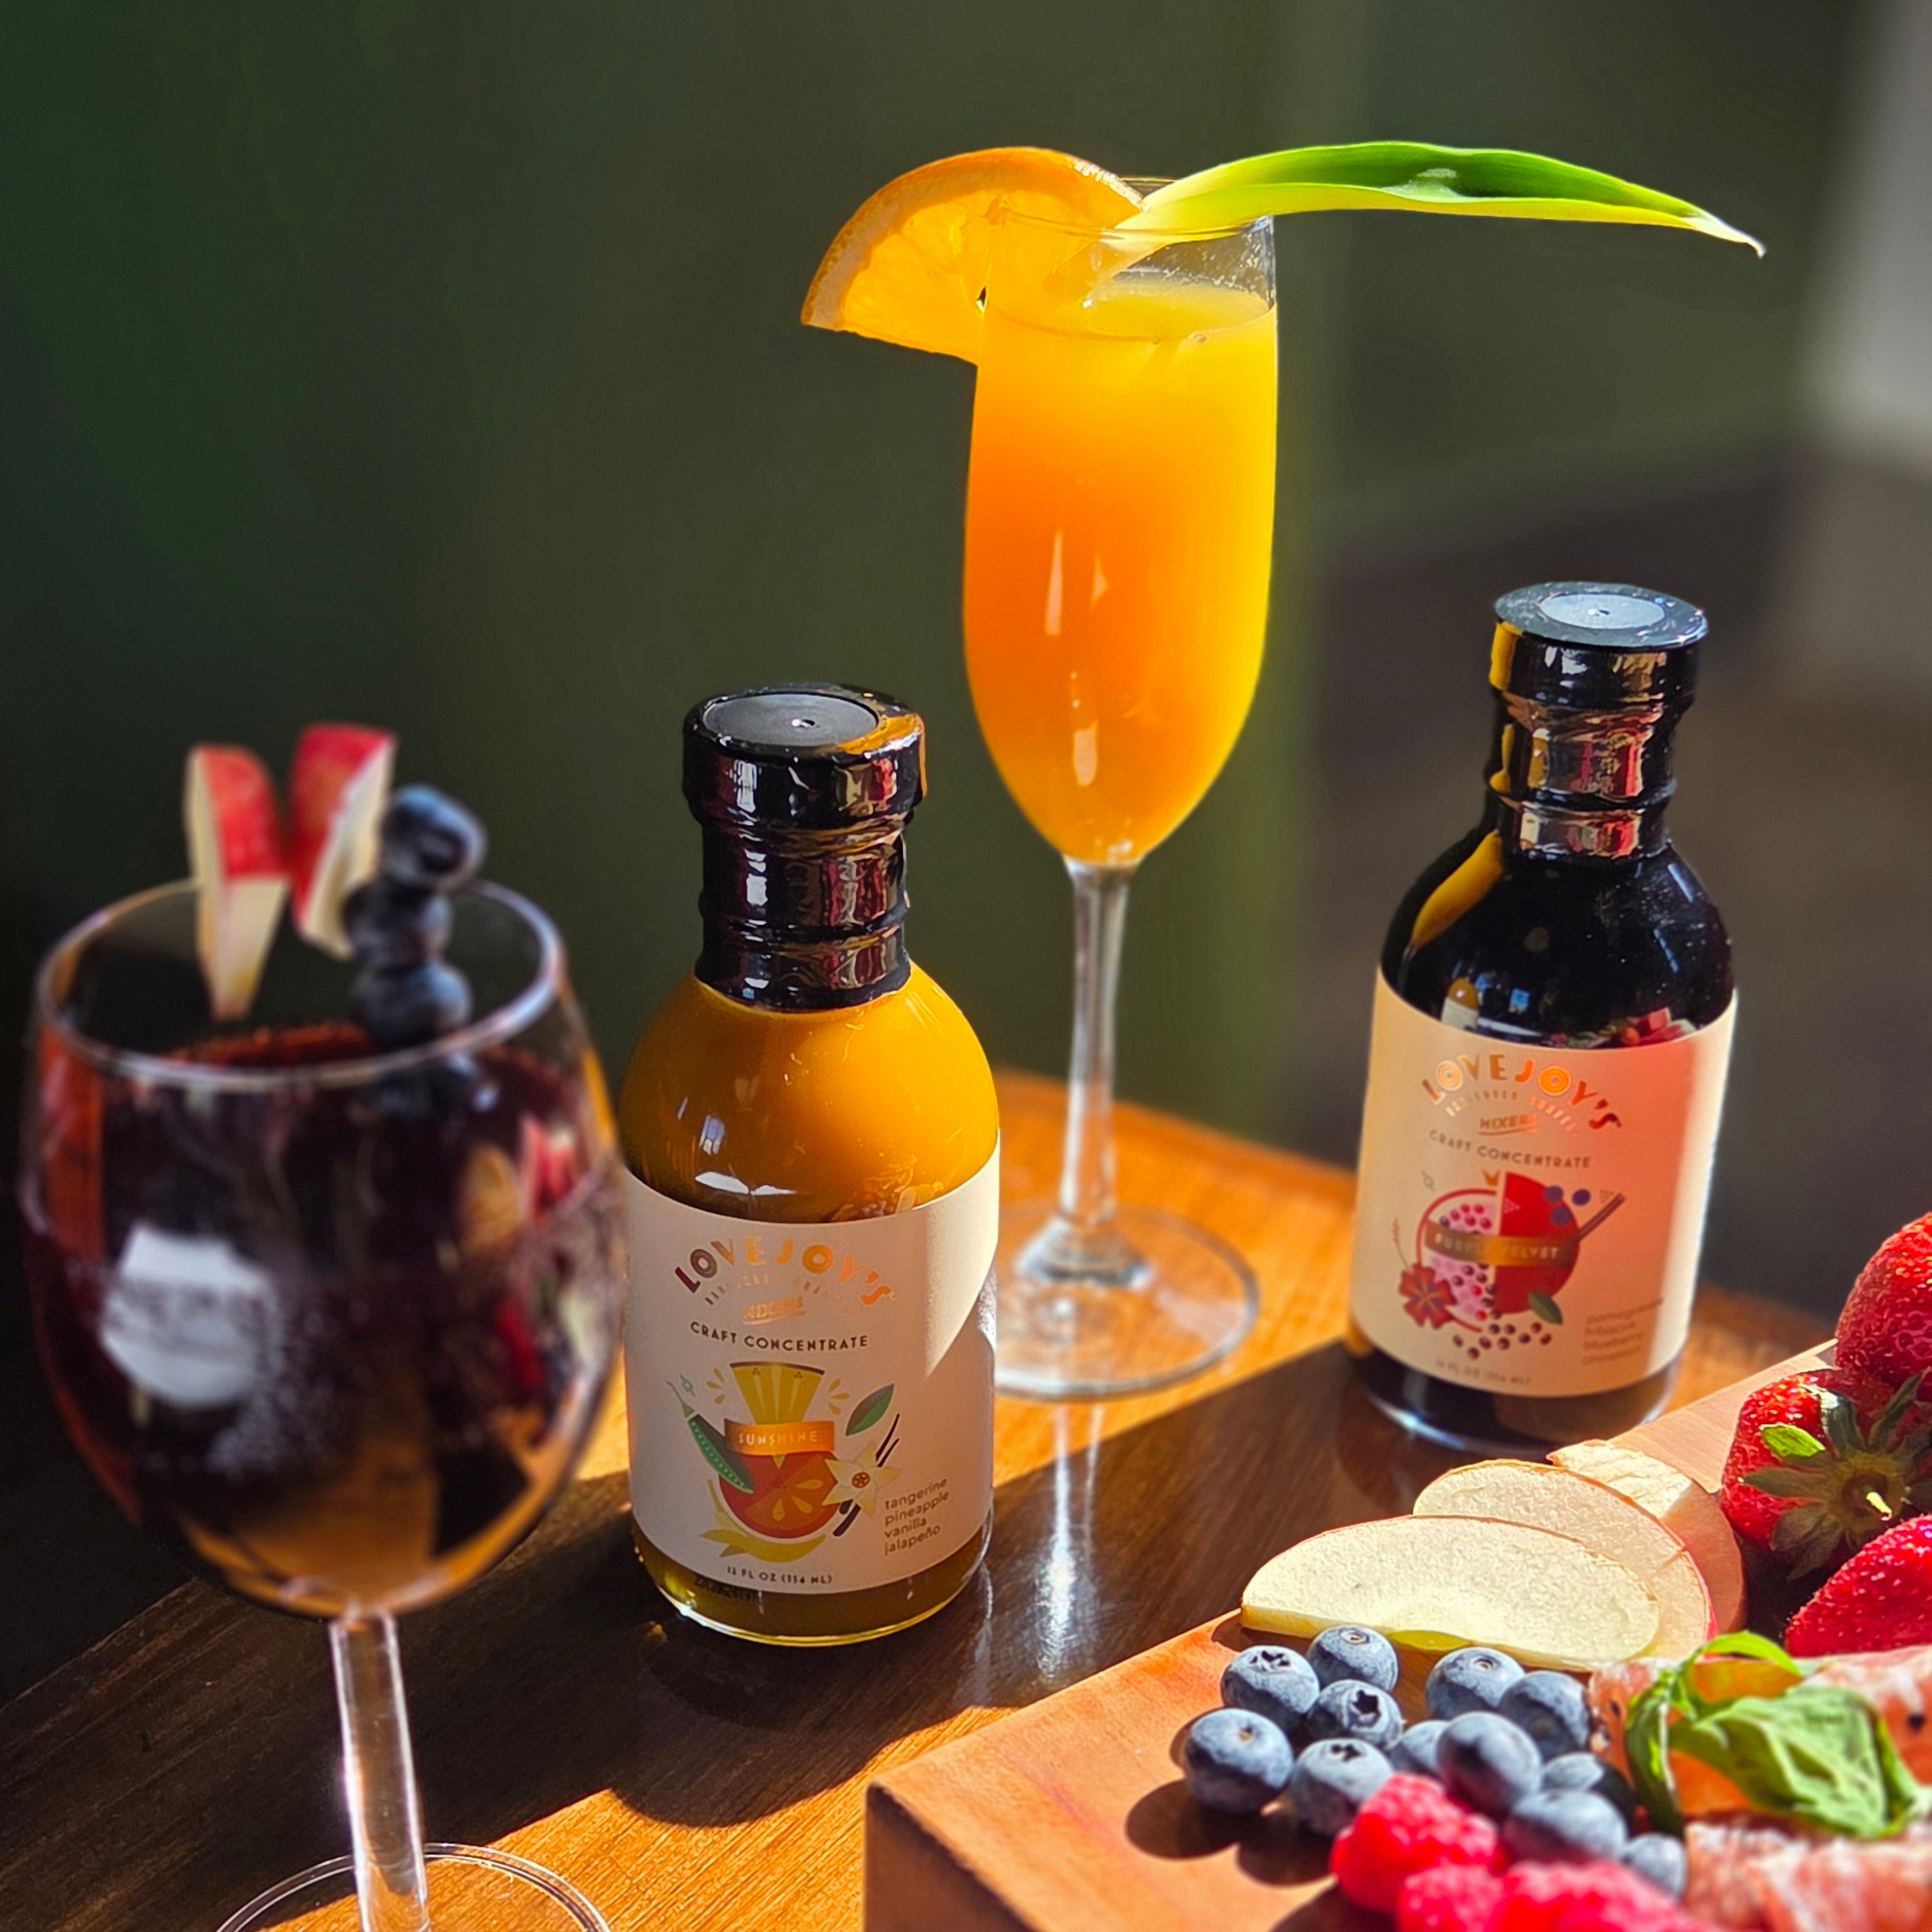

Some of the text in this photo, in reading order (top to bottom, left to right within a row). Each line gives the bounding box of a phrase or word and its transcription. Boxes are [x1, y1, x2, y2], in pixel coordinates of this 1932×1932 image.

[1421, 1053, 1621, 1129] LOVEJOY'S
[1429, 1128, 1590, 1168] CRAFT CONCENTRATE
[1435, 1233, 1490, 1256] PURP
[674, 1235, 894, 1306] LOVEJOY'S
[690, 1321, 868, 1352] CRAFT CONCENTRATE
[738, 1430, 818, 1446] SUNSHINE
[885, 1478, 948, 1510] tangerine
[885, 1491, 950, 1527] pineapple
[884, 1517, 927, 1539] vanilla
[885, 1525, 941, 1556] jalapeño
[741, 1568, 754, 1579] FL
[758, 1571, 777, 1582] OZ
[811, 1574, 833, 1584] ML)
